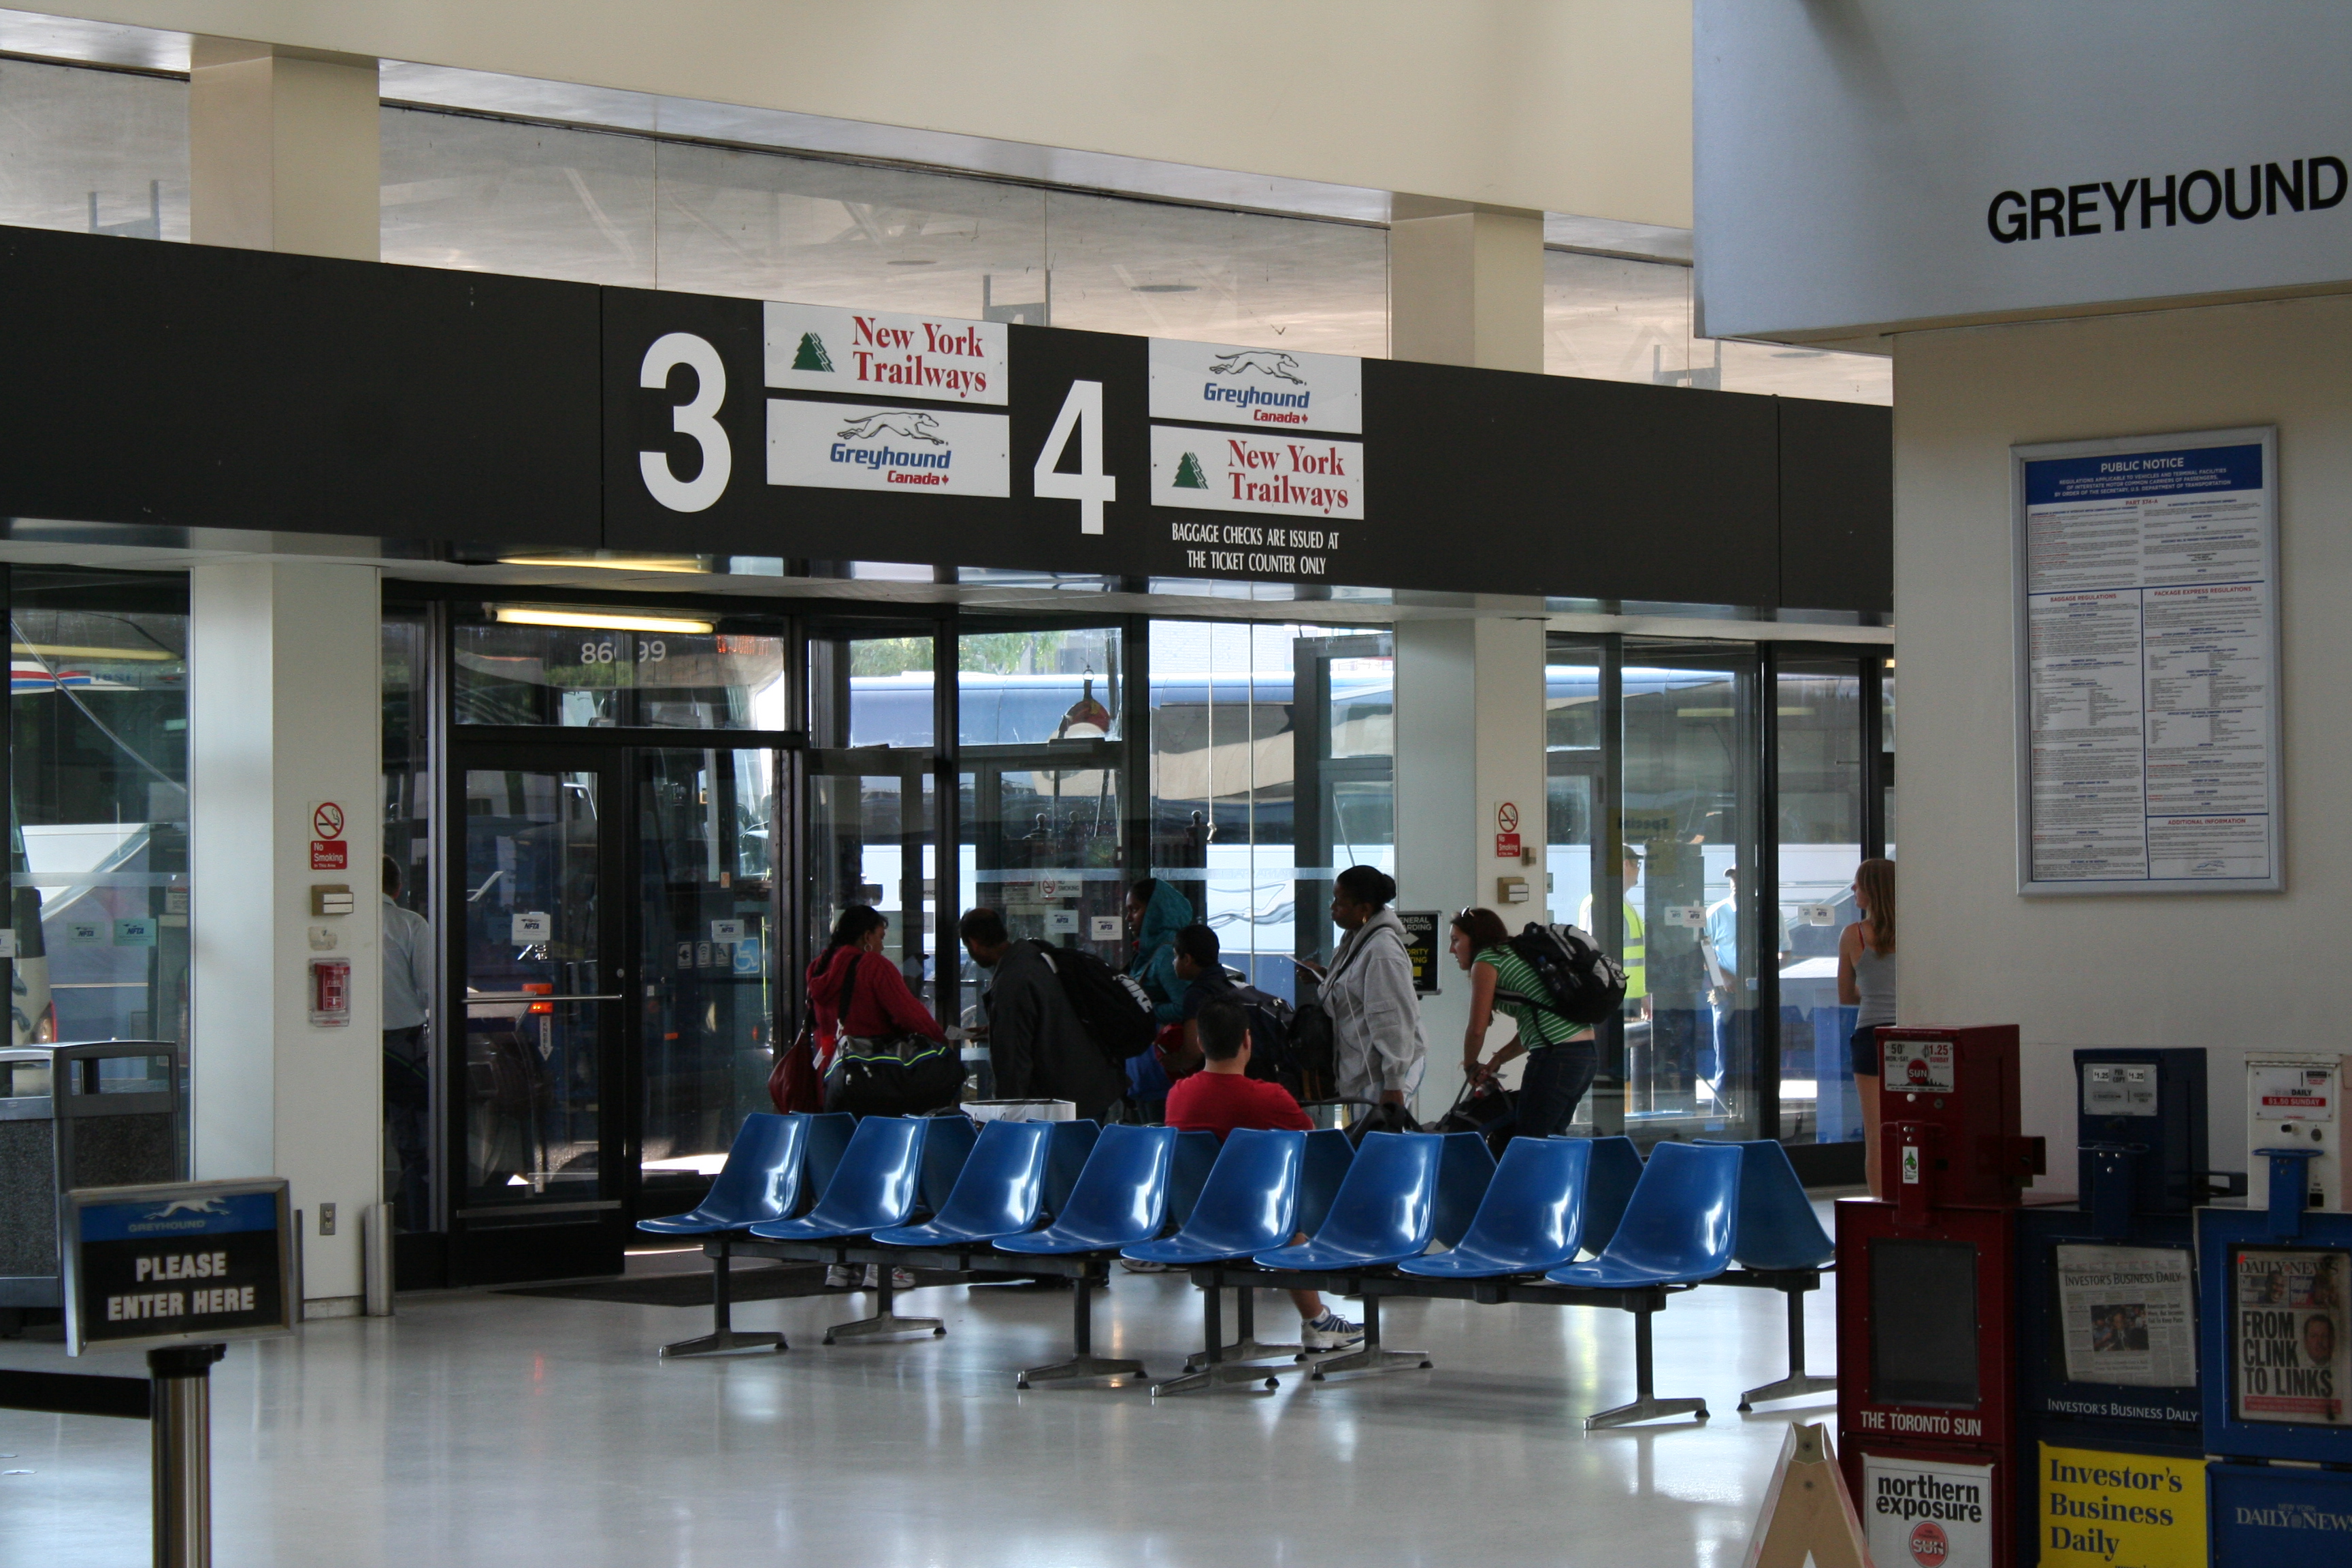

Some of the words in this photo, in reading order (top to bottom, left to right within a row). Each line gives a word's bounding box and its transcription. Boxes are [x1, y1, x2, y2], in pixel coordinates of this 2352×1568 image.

[1987, 156, 2349, 244] GREYHOUND
[852, 316, 916, 351] New
[921, 323, 985, 358] York
[852, 350, 987, 397] Trailways
[1203, 381, 1310, 410] Greyhound
[640, 332, 732, 513] 3
[1253, 409, 1301, 424] Canada
[830, 442, 951, 471] Greyhound
[1034, 380, 1116, 535] 4
[1227, 439, 1279, 473] New
[1284, 445, 1345, 477] York
[2101, 461, 2140, 473] PUBLIC
[2143, 458, 2184, 470] NOTICE
[887, 470, 940, 485] Canada
[1227, 472, 1348, 514] Trailways
[1171, 523, 1220, 544] BAGGAGE
[1223, 525, 1262, 546] CHECKS
[1266, 528, 1285, 546] ARE
[1289, 529, 1322, 549] ISSUED
[1325, 532, 1339, 550] AT
[1187, 549, 1206, 570] THE
[1209, 550, 1244, 572] TICKET
[1248, 553, 1295, 574] COUNTER
[1299, 555, 1326, 576] ONLY
[581, 640, 666, 664] 8699
[314, 843, 324, 851] No
[314, 853, 343, 864] Smoking
[1499, 844, 1518, 852] Smoking
[1908, 1069, 1927, 1077] SUN
[128, 1220, 206, 1233] GREYHOUND
[135, 1252, 227, 1282] PLEASE
[2065, 1274, 2112, 1286] INVESTOR'S
[2114, 1273, 2155, 1284] BUSINESS
[2156, 1271, 2181, 1282] DAILY
[2240, 1261, 2284, 1275] DAILY
[108, 1292, 184, 1321] ENTER
[193, 1286, 255, 1315] HERE
[2242, 1311, 2294, 1339] FROM
[2243, 1339, 2300, 1367] CLINK
[2244, 1367, 2268, 1395] TO
[2274, 1368, 2333, 1398] LINKS
[2048, 1398, 2108, 1415] INVESTOR'S
[2110, 1403, 2163, 1419] BUSINESS
[2166, 1407, 2198, 1422] DAILY
[1860, 1411, 1885, 1429] THE
[1889, 1413, 1949, 1434] TORONTO
[1954, 1418, 1982, 1437] SUN
[2050, 1459, 2183, 1492] Investor's
[1878, 1475, 1979, 1504] northern
[1876, 1496, 1982, 1523] exposure
[2050, 1492, 2173, 1526] Business
[2236, 1507, 2291, 1528] DAILY
[1912, 1539, 1944, 1556] SUN
[2051, 1526, 2120, 1562] Daily
